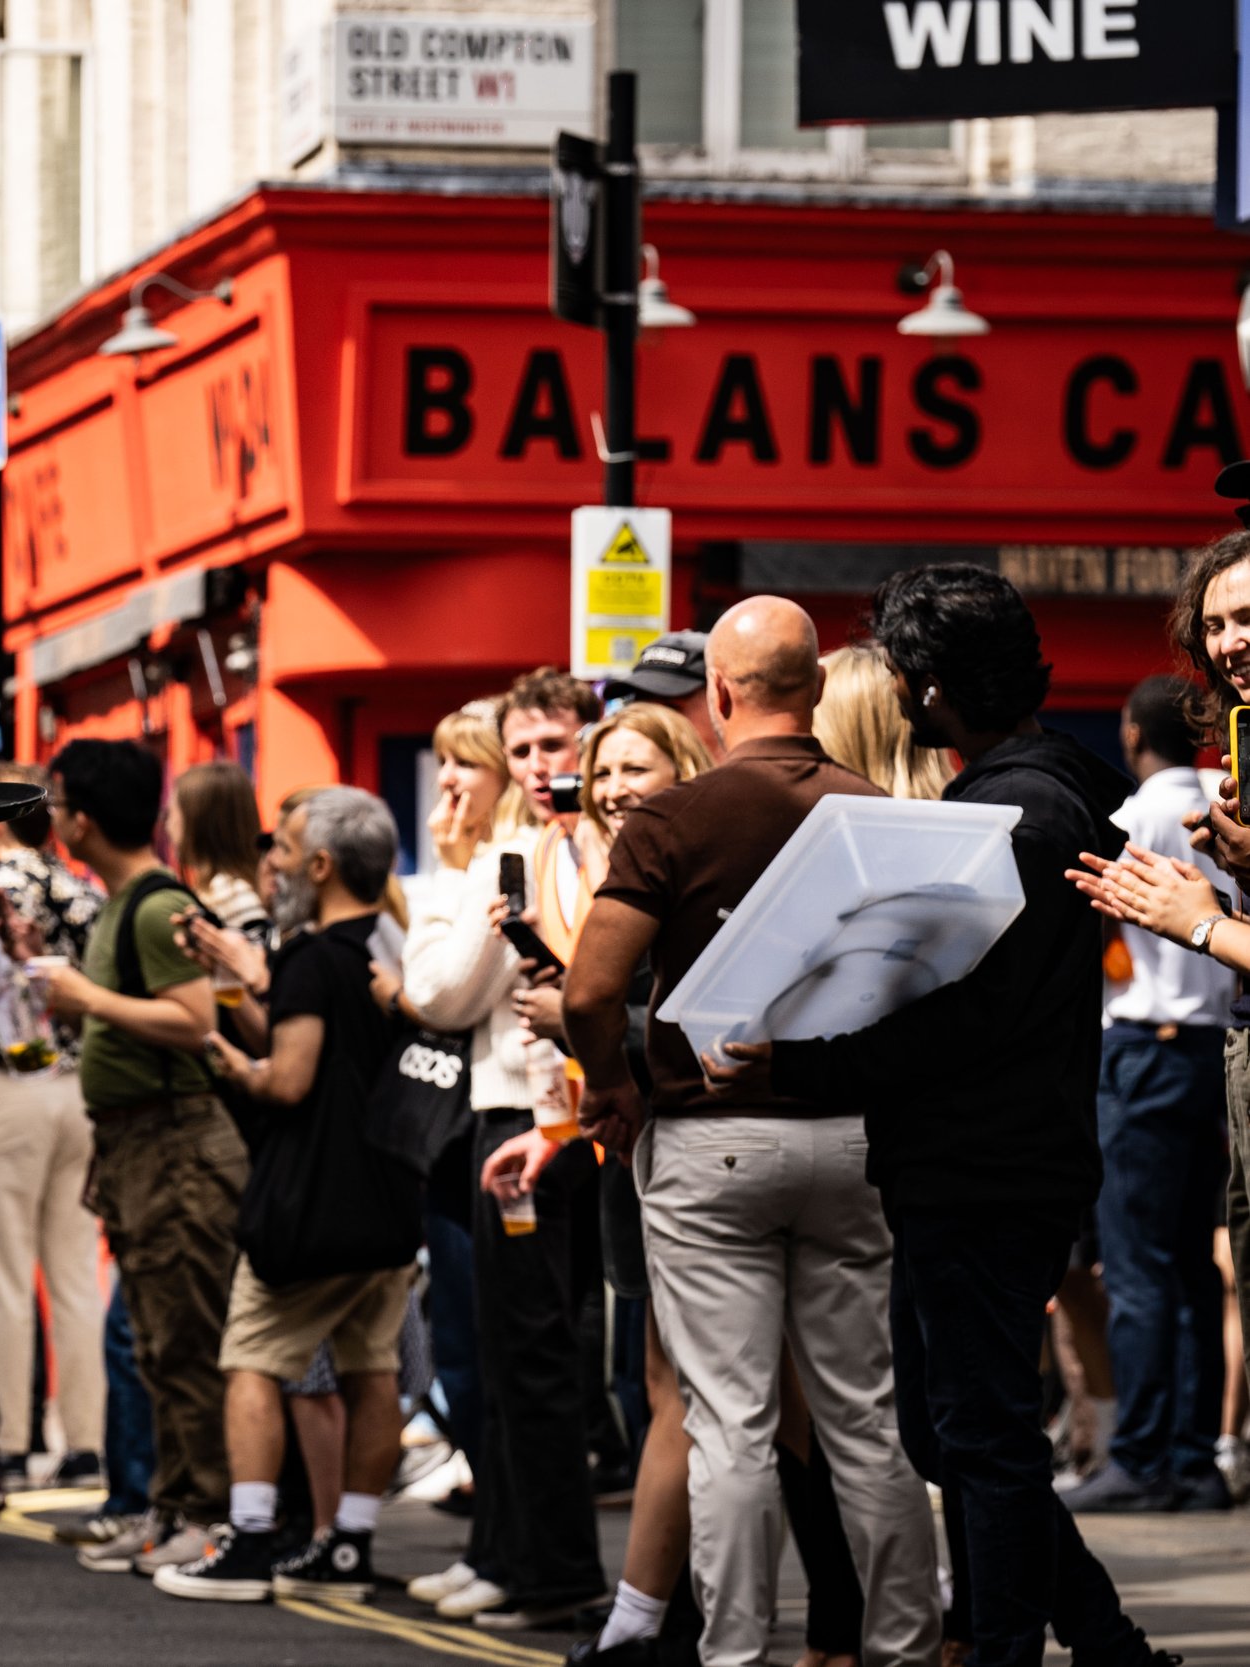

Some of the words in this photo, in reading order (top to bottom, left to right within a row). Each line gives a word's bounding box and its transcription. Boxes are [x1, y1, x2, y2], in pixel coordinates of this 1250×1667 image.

[348, 25, 409, 61] OLD
[419, 27, 573, 65] COMPTON
[884, 0, 1140, 69] WINE
[348, 65, 459, 101] STREET
[471, 69, 516, 101] W1
[404, 344, 982, 470] BAANS
